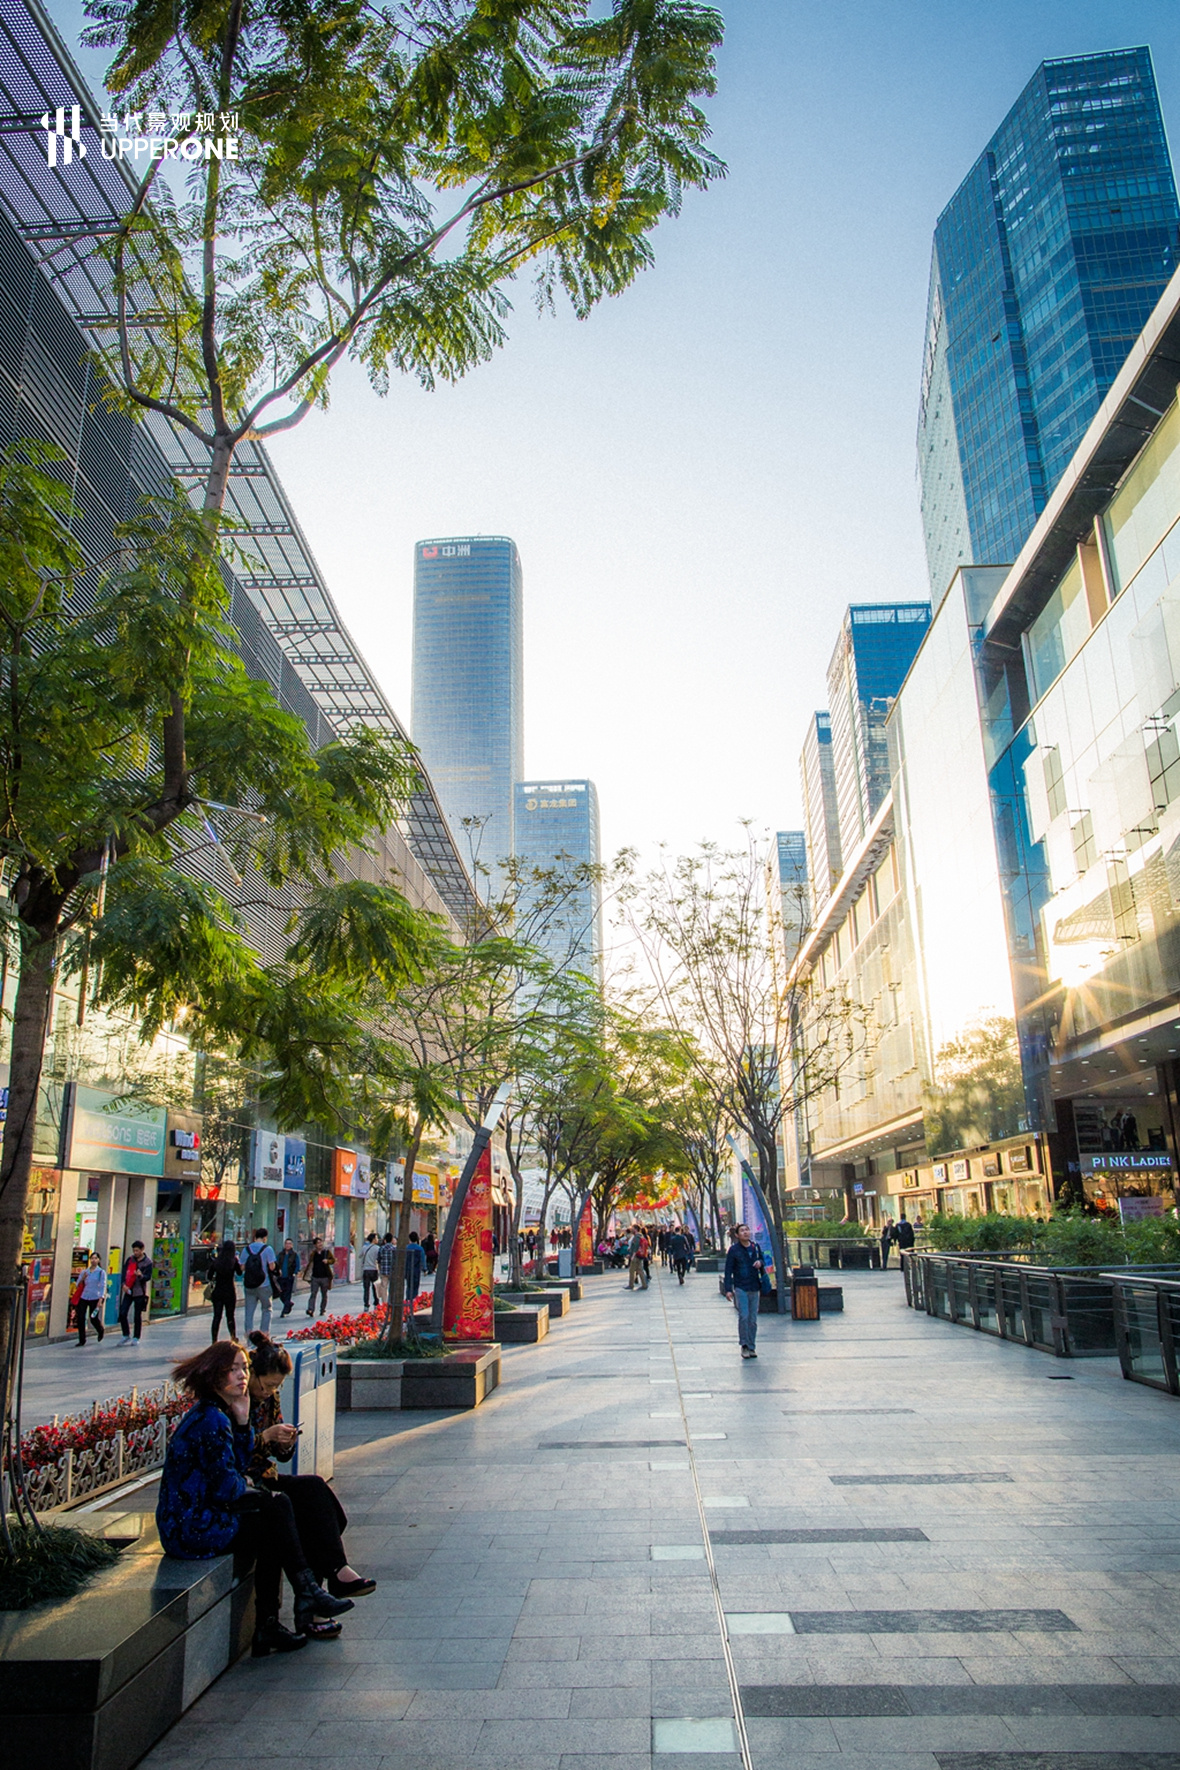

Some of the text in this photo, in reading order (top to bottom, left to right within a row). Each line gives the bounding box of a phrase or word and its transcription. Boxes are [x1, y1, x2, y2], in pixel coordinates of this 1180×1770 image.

[442, 545, 471, 557] 中洲
[457, 1216, 492, 1322] 新年快乐
